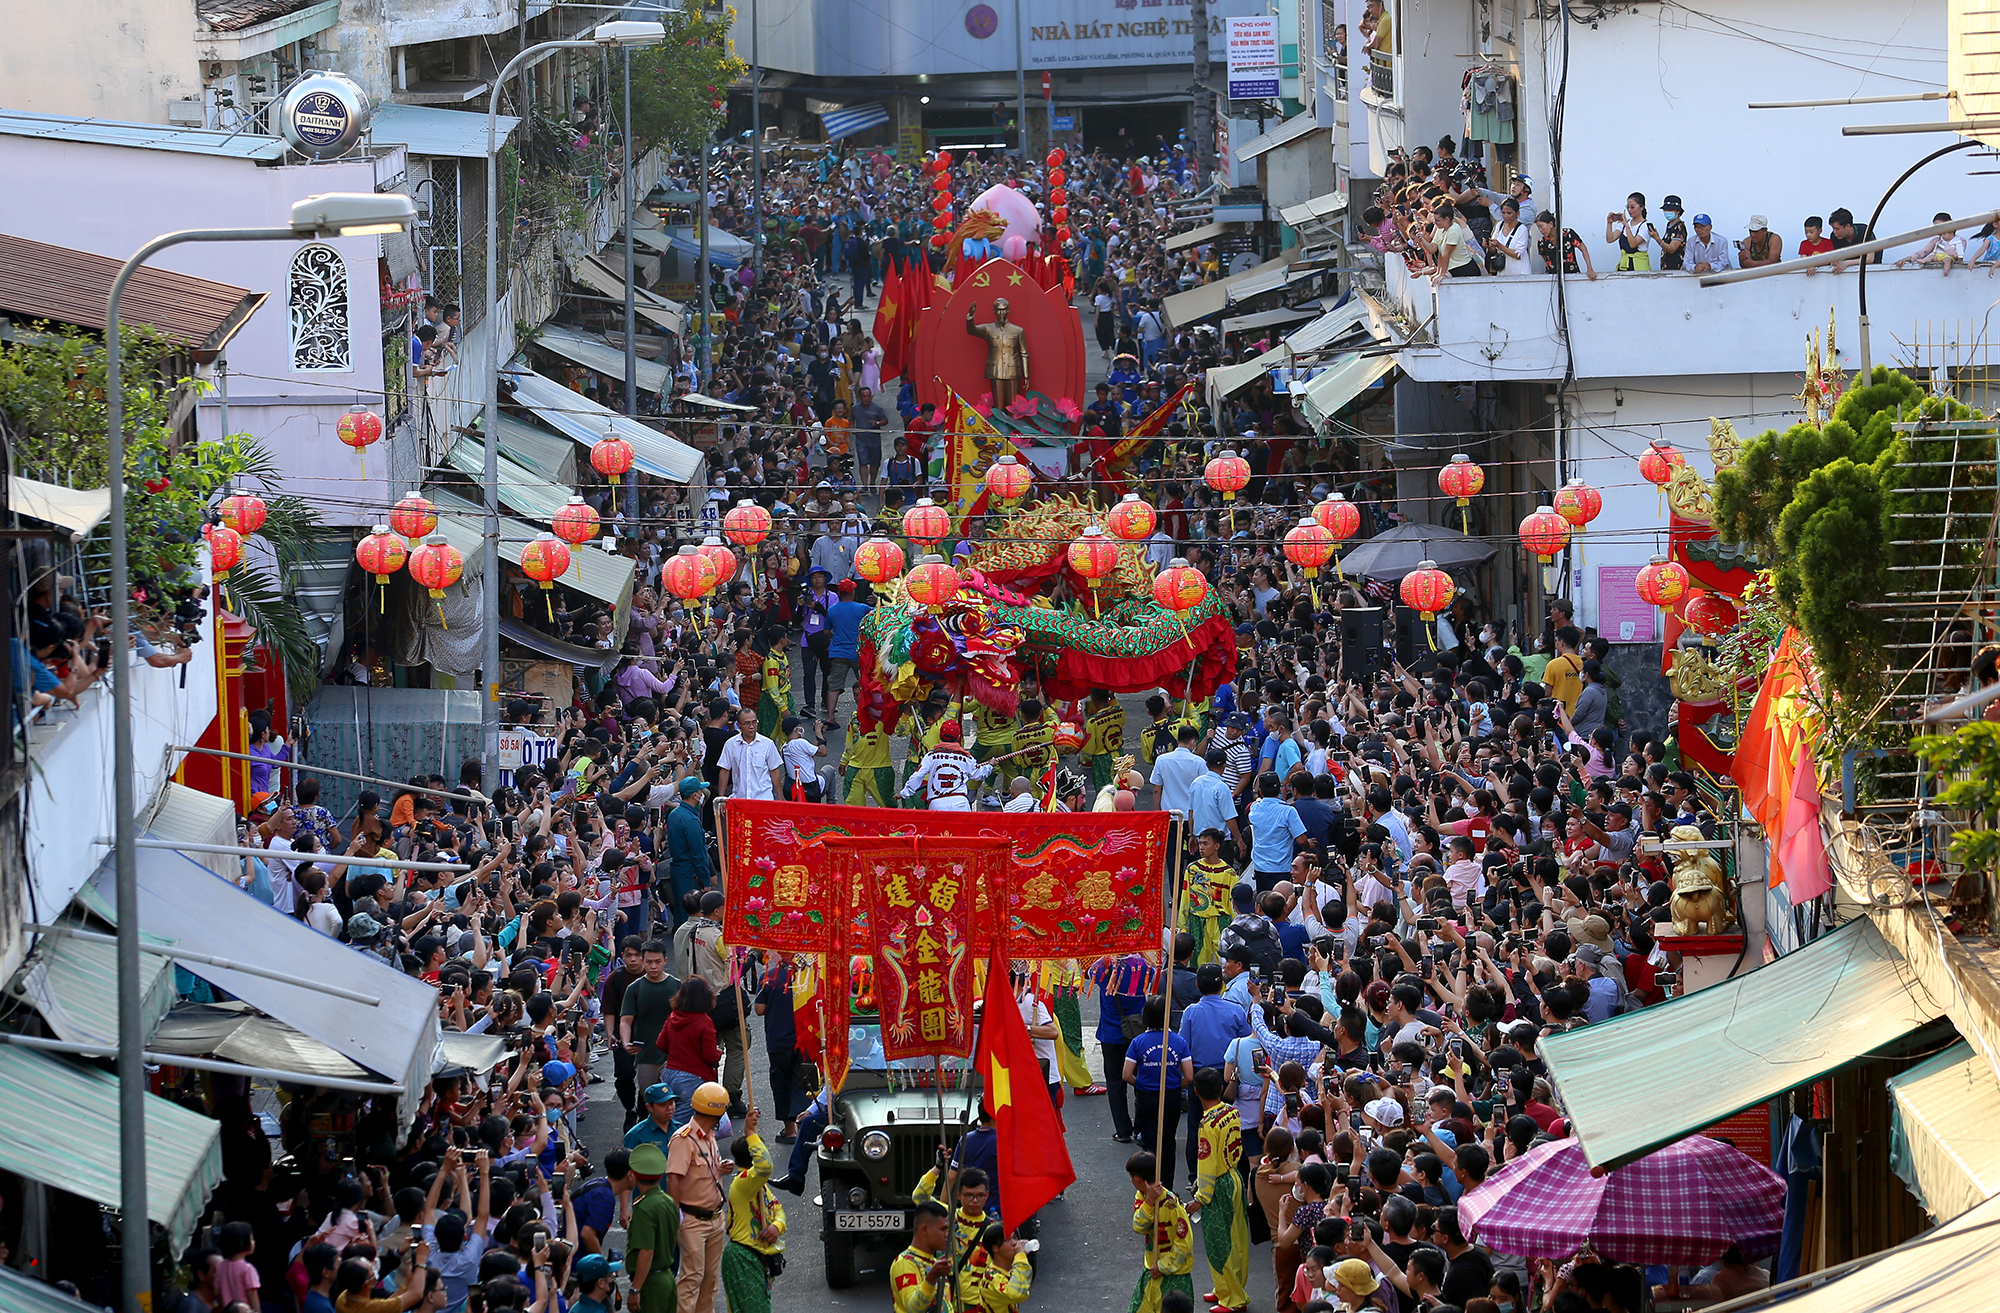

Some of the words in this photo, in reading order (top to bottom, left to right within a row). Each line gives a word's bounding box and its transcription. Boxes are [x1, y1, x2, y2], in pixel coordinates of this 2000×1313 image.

[1031, 20, 1071, 41] NHÀ
[1075, 20, 1113, 40] HÁT
[1117, 17, 1168, 38] NGHỆ
[318, 98, 328, 106] 12
[511, 740, 519, 750] 5A
[1146, 1046, 1156, 1054] BAN
